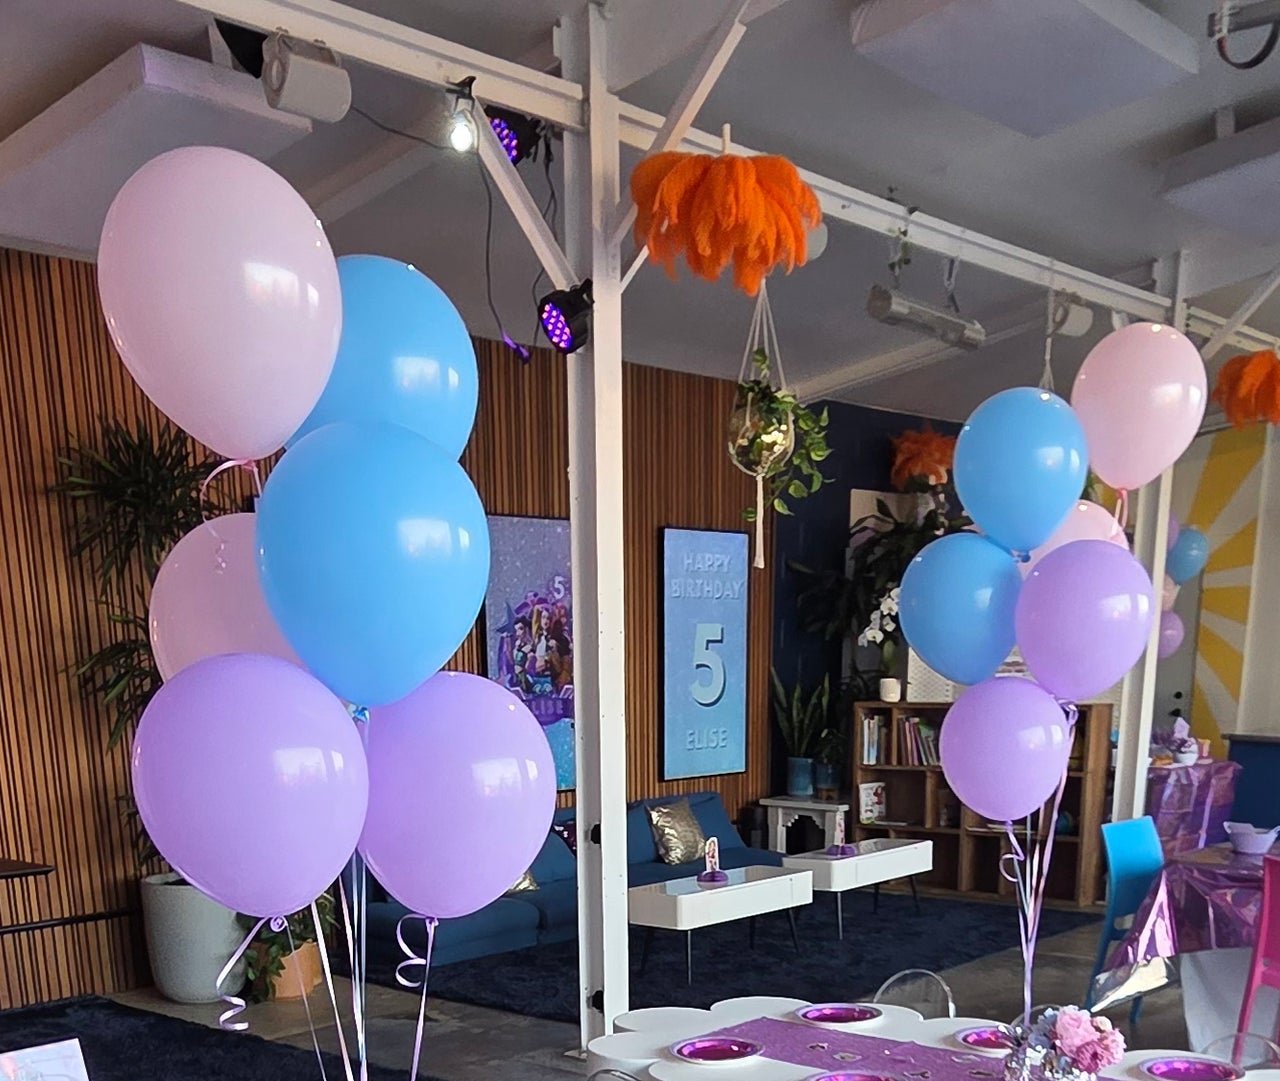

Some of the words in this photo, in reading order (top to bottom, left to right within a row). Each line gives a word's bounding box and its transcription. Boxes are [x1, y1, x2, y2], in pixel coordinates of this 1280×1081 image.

[683, 552, 731, 572] HAPPY
[554, 575, 565, 600] 5
[670, 578, 745, 600] BIRTHDAY
[691, 623, 726, 707] 5
[527, 699, 564, 715] LISE
[685, 729, 729, 751] ELISE
